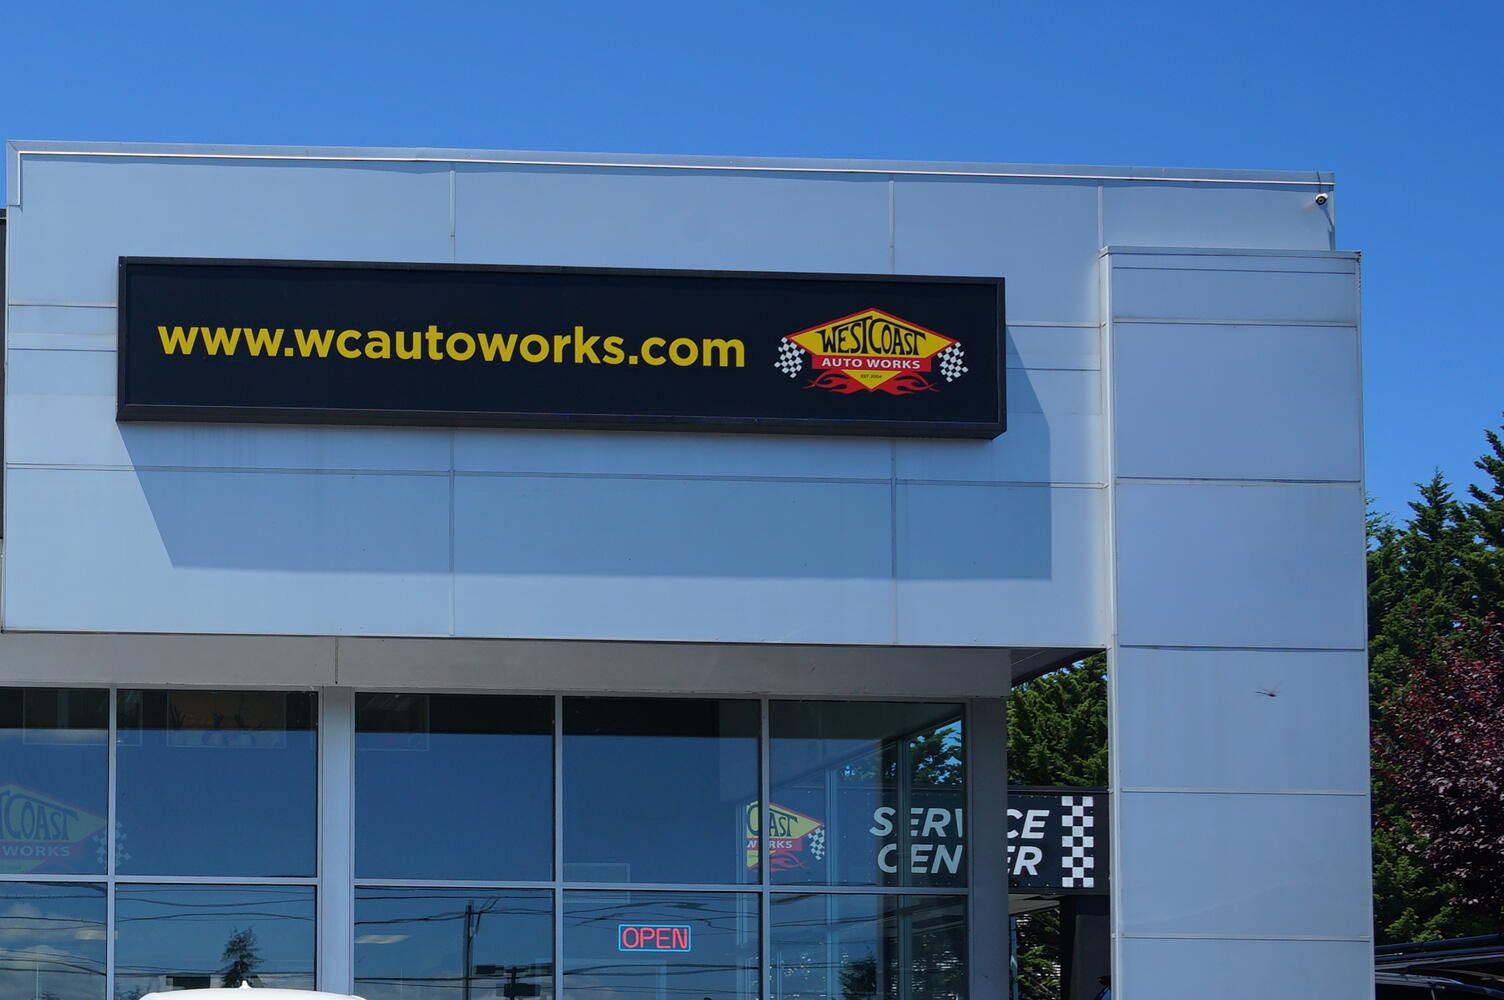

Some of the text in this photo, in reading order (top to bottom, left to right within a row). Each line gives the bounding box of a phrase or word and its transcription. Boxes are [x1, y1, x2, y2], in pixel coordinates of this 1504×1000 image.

[158, 325, 745, 367] www.wcautoworks.com
[821, 358, 921, 369] AUTO WORKS
[2, 845, 71, 857] WORKS
[622, 927, 688, 949] OPEN
